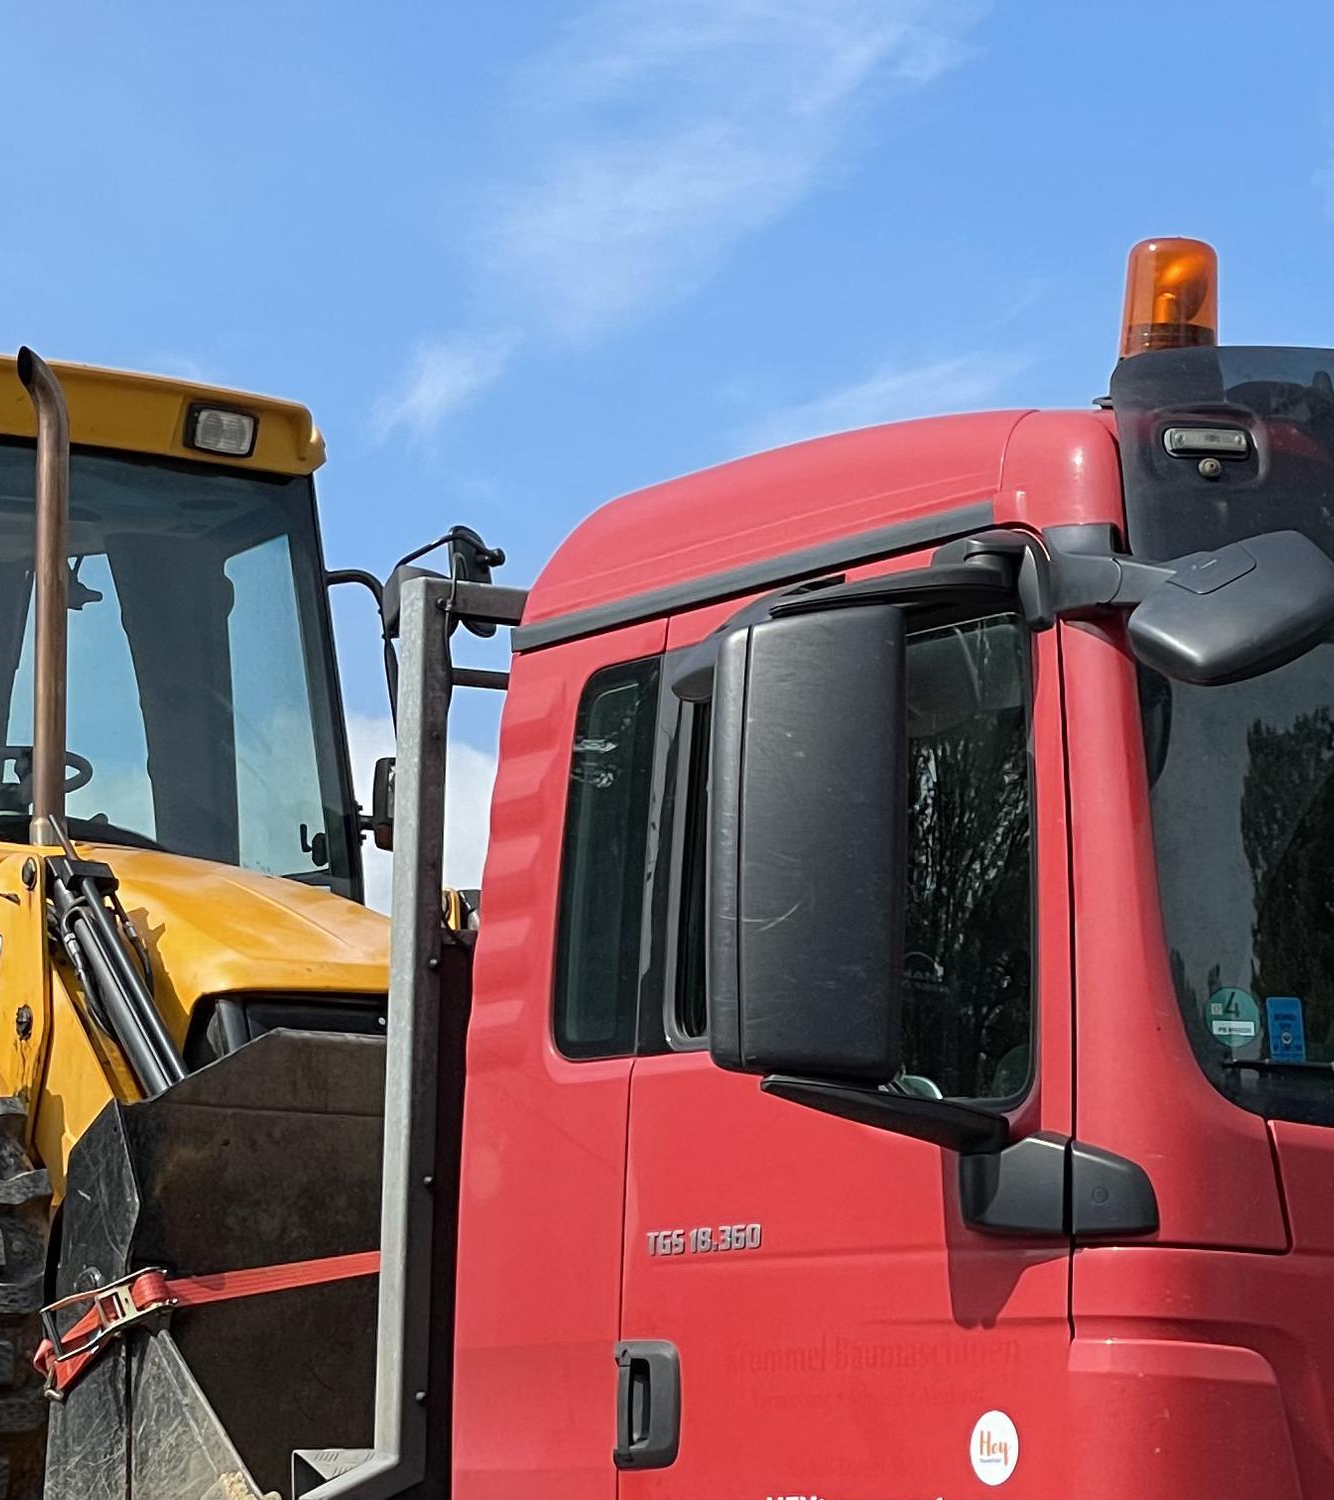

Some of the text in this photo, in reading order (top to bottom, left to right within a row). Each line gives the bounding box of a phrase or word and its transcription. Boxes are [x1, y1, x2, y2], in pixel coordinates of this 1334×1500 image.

[1224, 991, 1241, 1019] 4
[646, 1229, 685, 1257] TGS
[979, 1429, 1010, 1467] Hey
